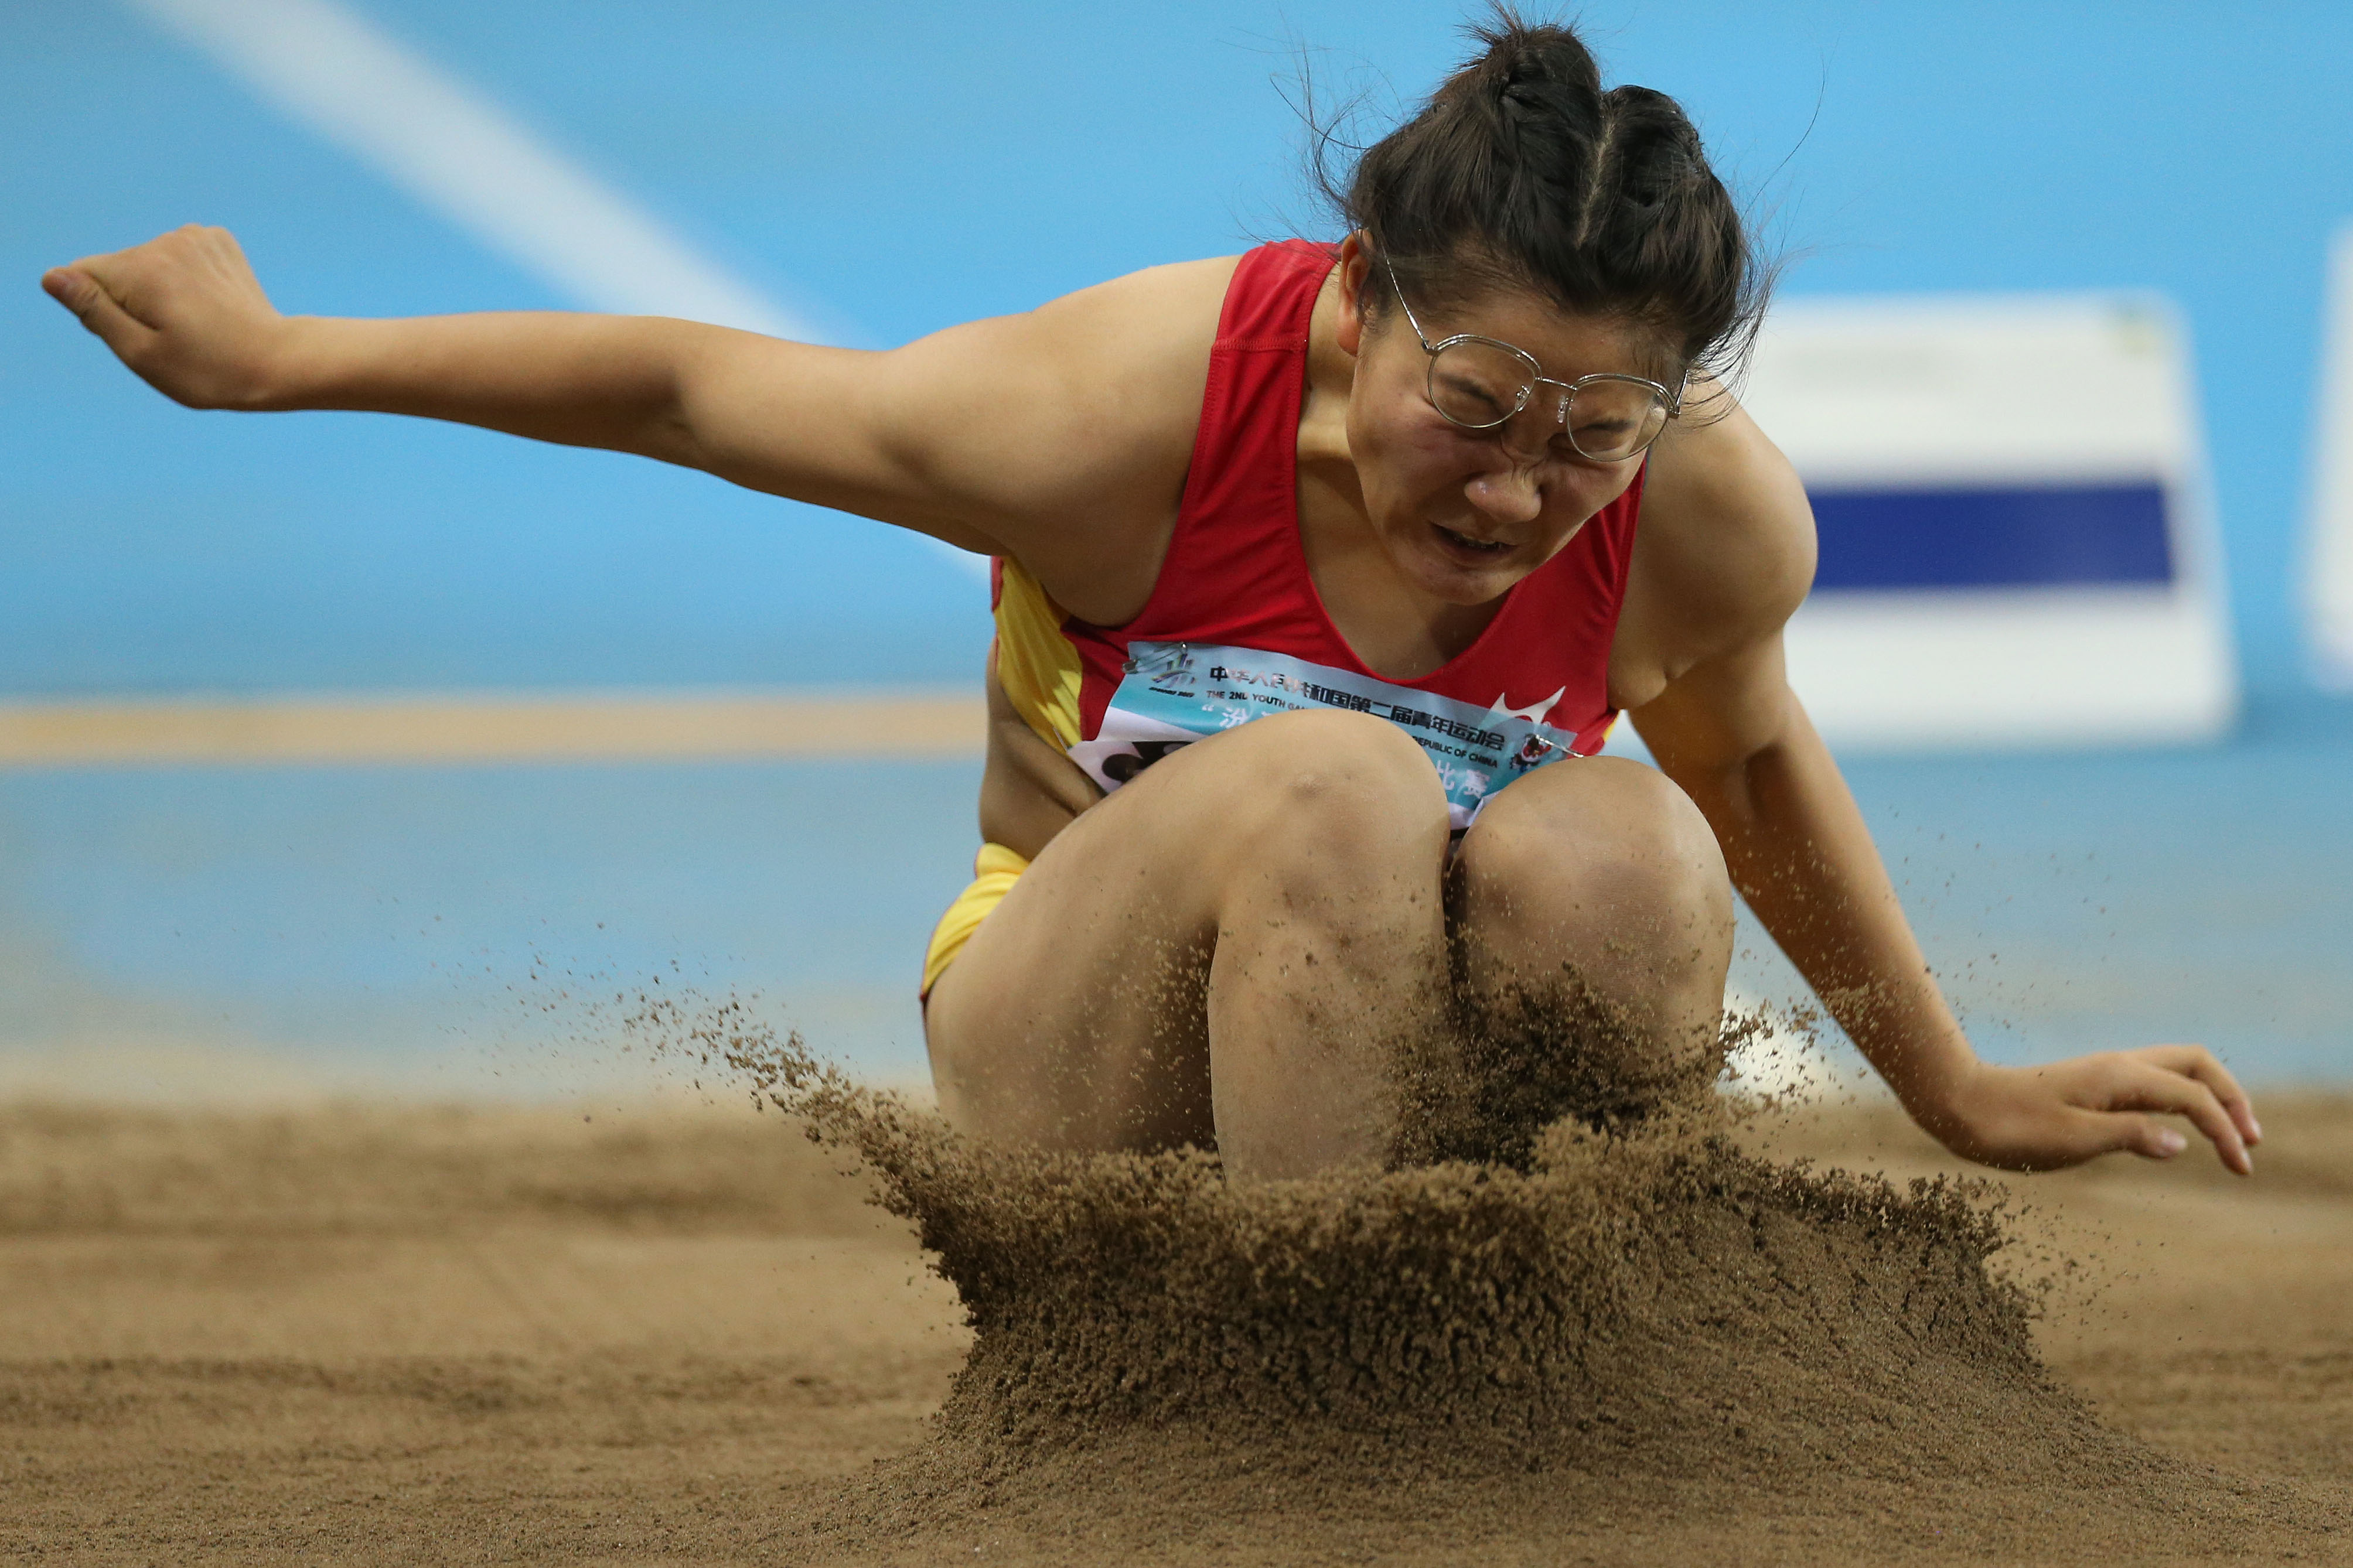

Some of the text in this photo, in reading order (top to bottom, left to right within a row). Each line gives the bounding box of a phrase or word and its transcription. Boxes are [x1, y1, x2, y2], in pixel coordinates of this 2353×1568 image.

[1206, 691, 1225, 699] THE
[1253, 694, 1285, 708] YOUTH
[1454, 749, 1467, 757] OF
[1469, 753, 1498, 768] CHINA
